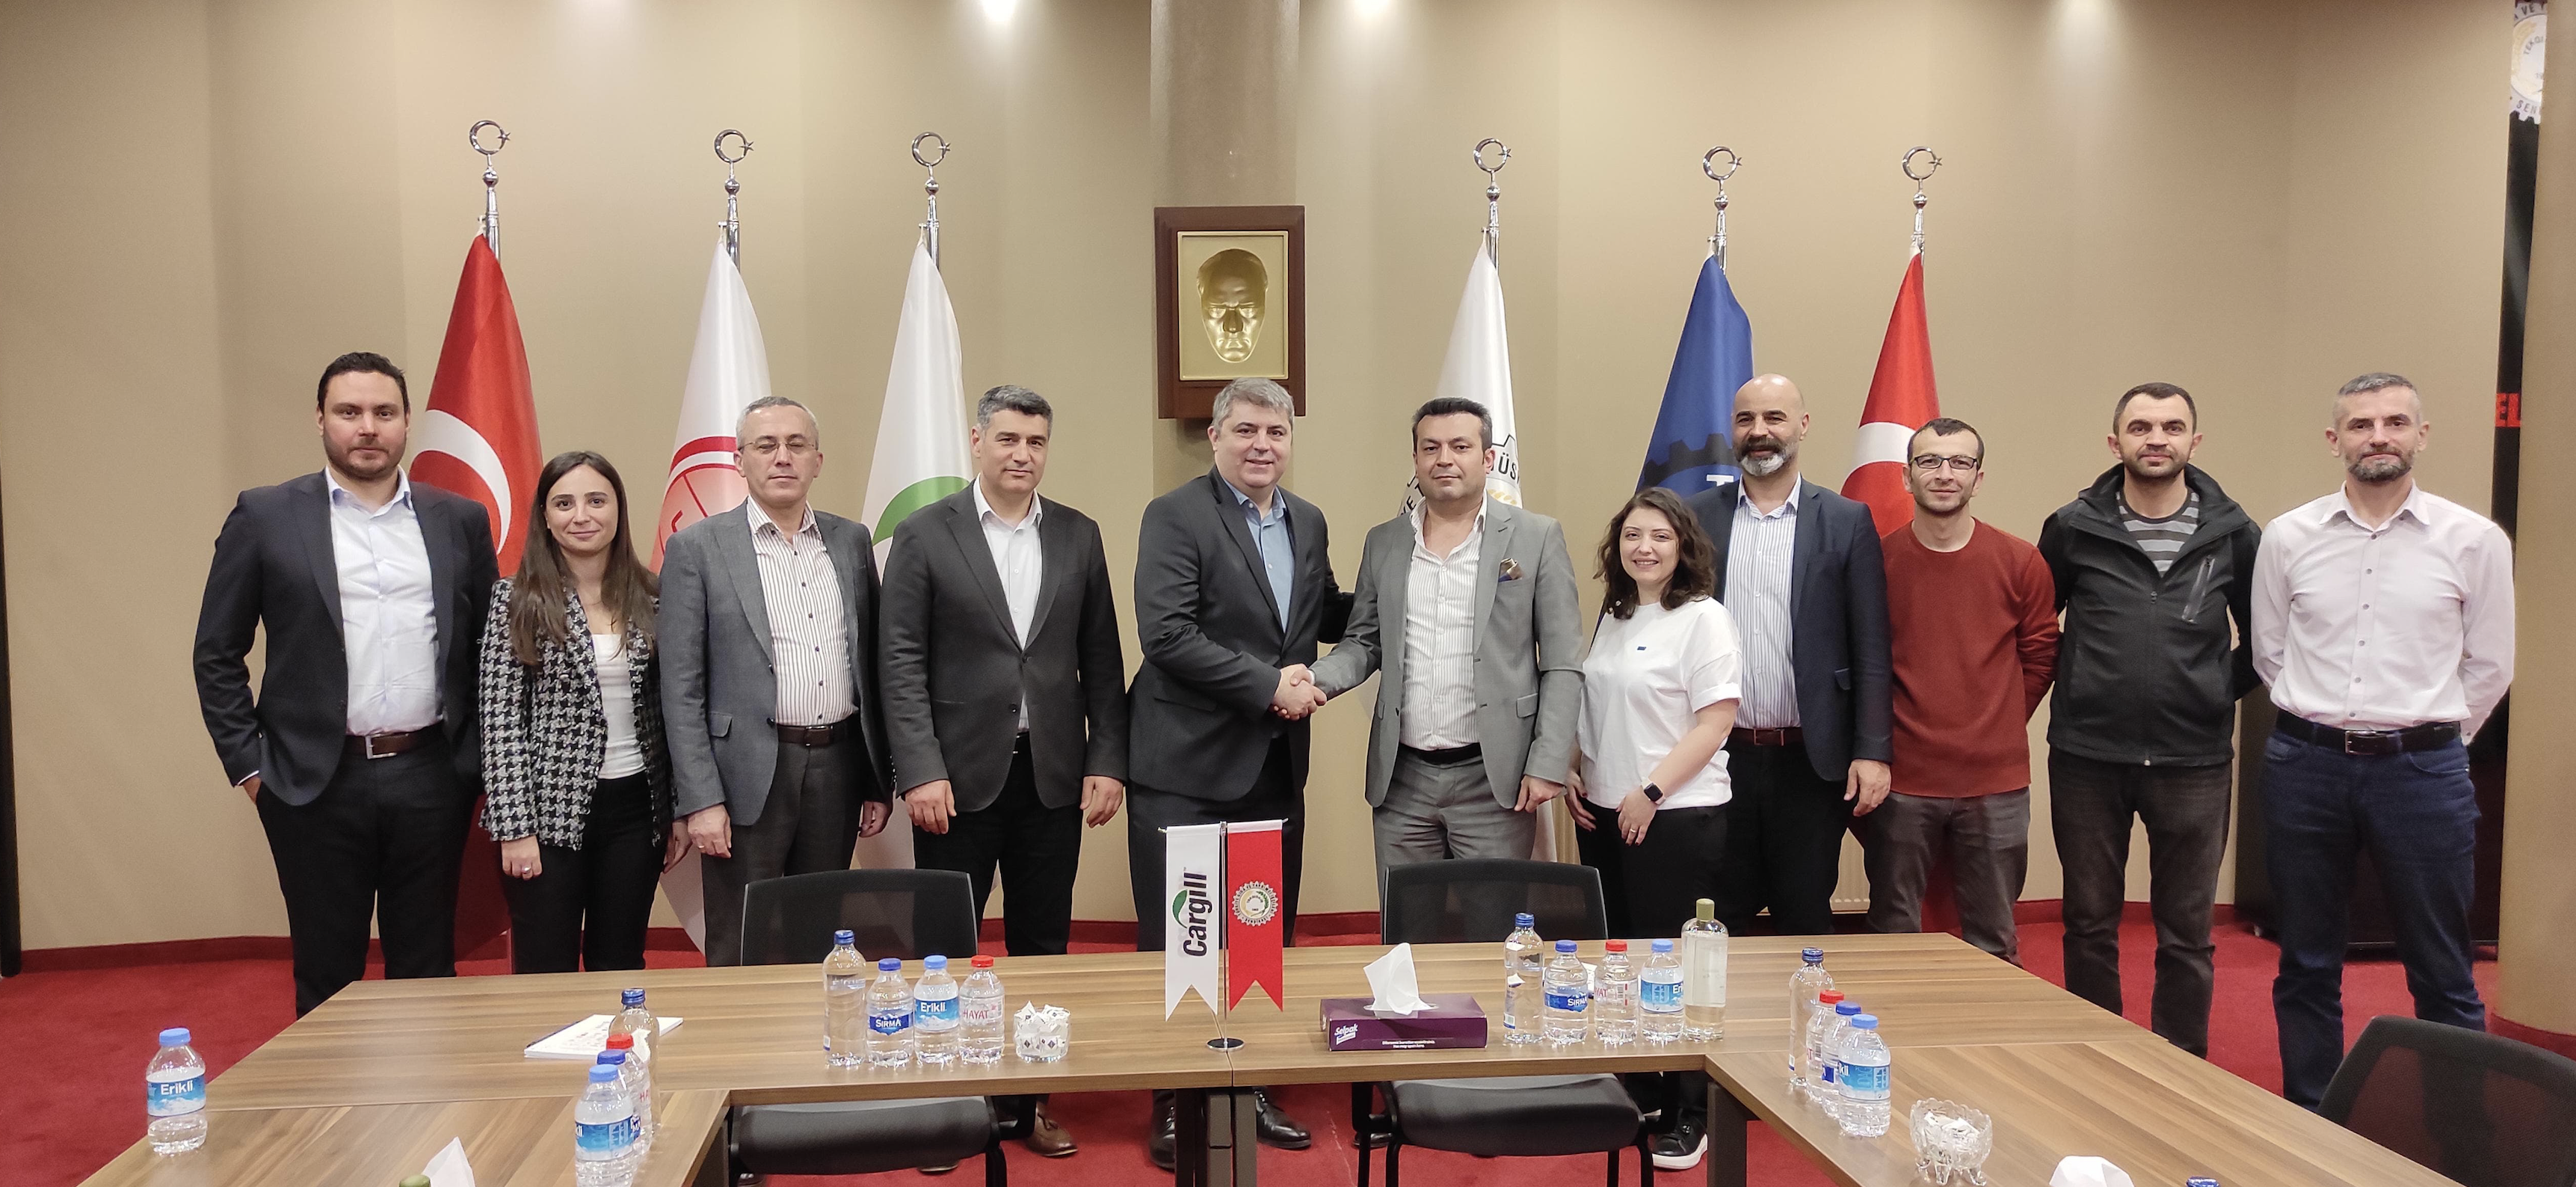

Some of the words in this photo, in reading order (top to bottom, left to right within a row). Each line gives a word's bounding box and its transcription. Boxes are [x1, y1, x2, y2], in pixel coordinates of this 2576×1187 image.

[1183, 872, 1212, 957] Cargill
[920, 1002, 946, 1012] Erikli
[964, 1009, 990, 1020] HAYAT
[1334, 1023, 1358, 1035] Selpak
[161, 1080, 193, 1095] Erikli
